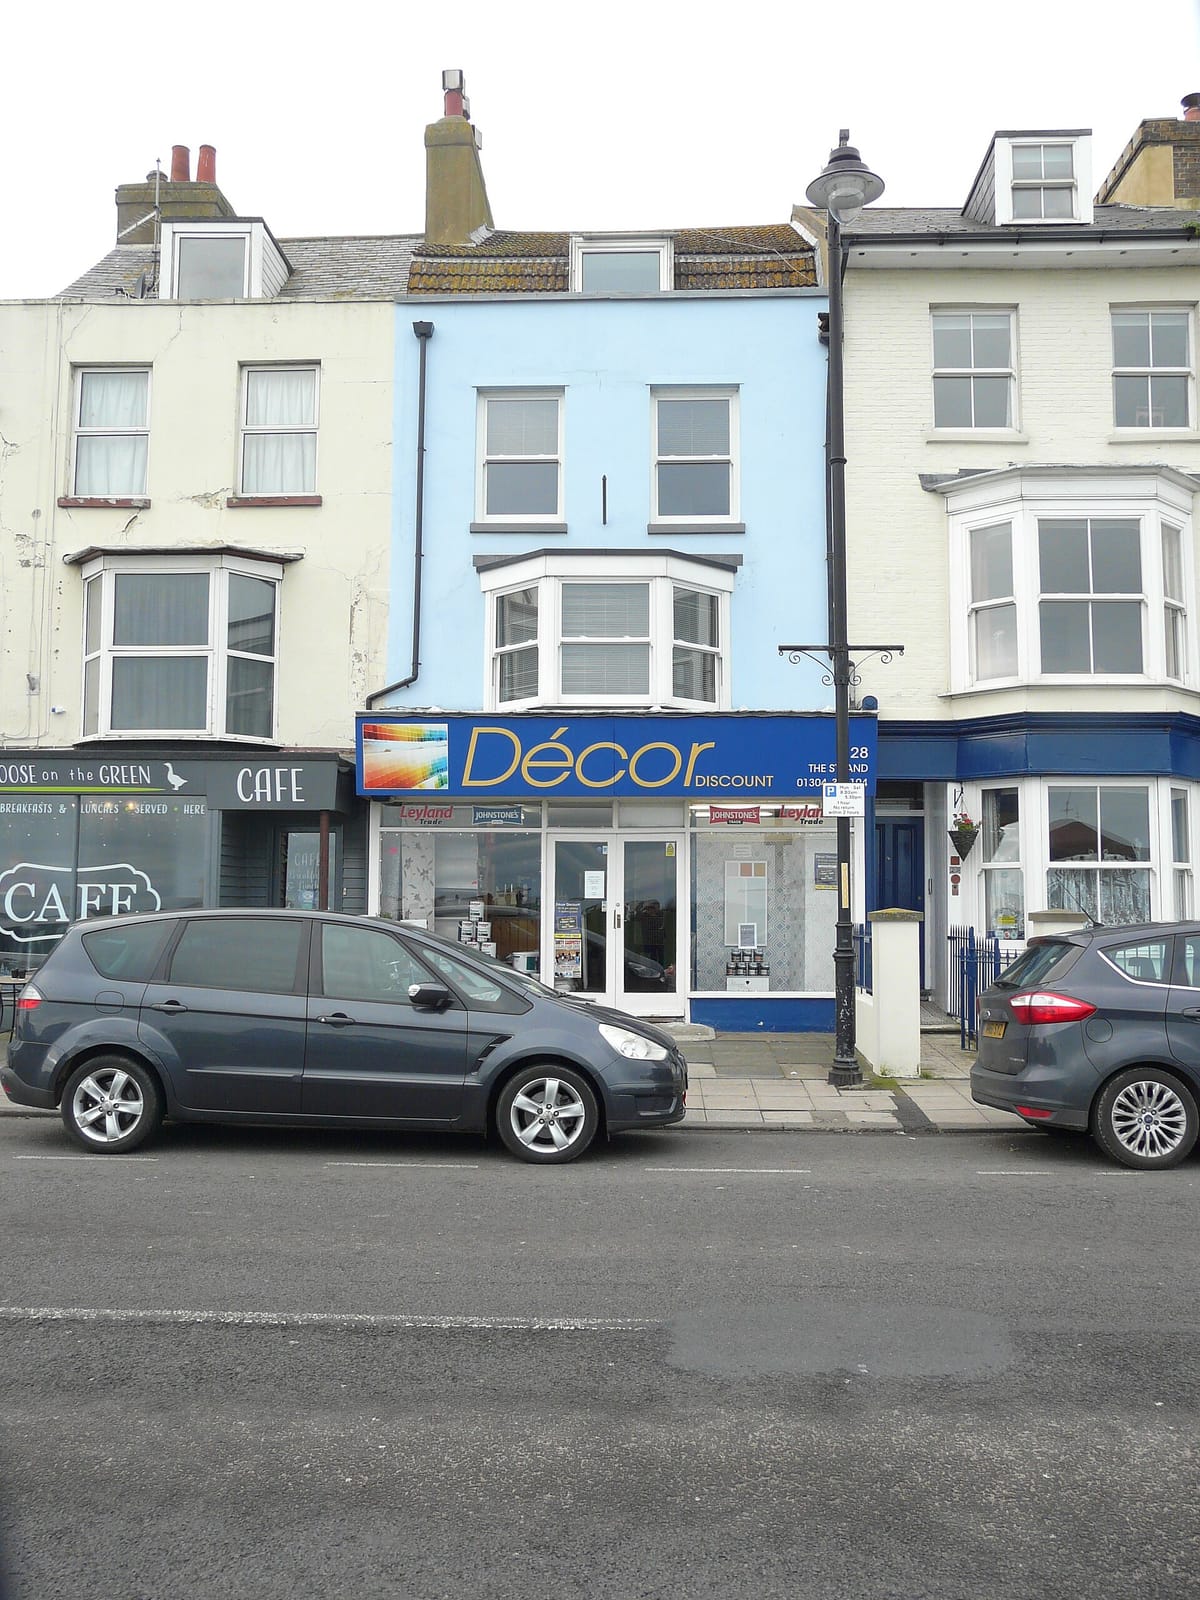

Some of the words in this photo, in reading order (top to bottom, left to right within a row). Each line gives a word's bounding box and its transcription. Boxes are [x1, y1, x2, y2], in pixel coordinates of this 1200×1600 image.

[461, 727, 716, 788] Décor
[850, 747, 869, 759] 28
[42, 771, 58, 781] on
[69, 767, 94, 781] the
[99, 765, 151, 784] GREEN
[808, 763, 827, 773] THE
[236, 768, 305, 802] CAFE
[695, 775, 774, 787] DISCOUNT
[0, 803, 53, 814] BREAKFASTS
[80, 803, 119, 814] LUNCHES
[135, 803, 168, 815] SERVED
[183, 804, 205, 815] HERE
[400, 805, 454, 822] Leyland
[780, 804, 823, 821] Leylan
[4, 882, 137, 923] CAFE
